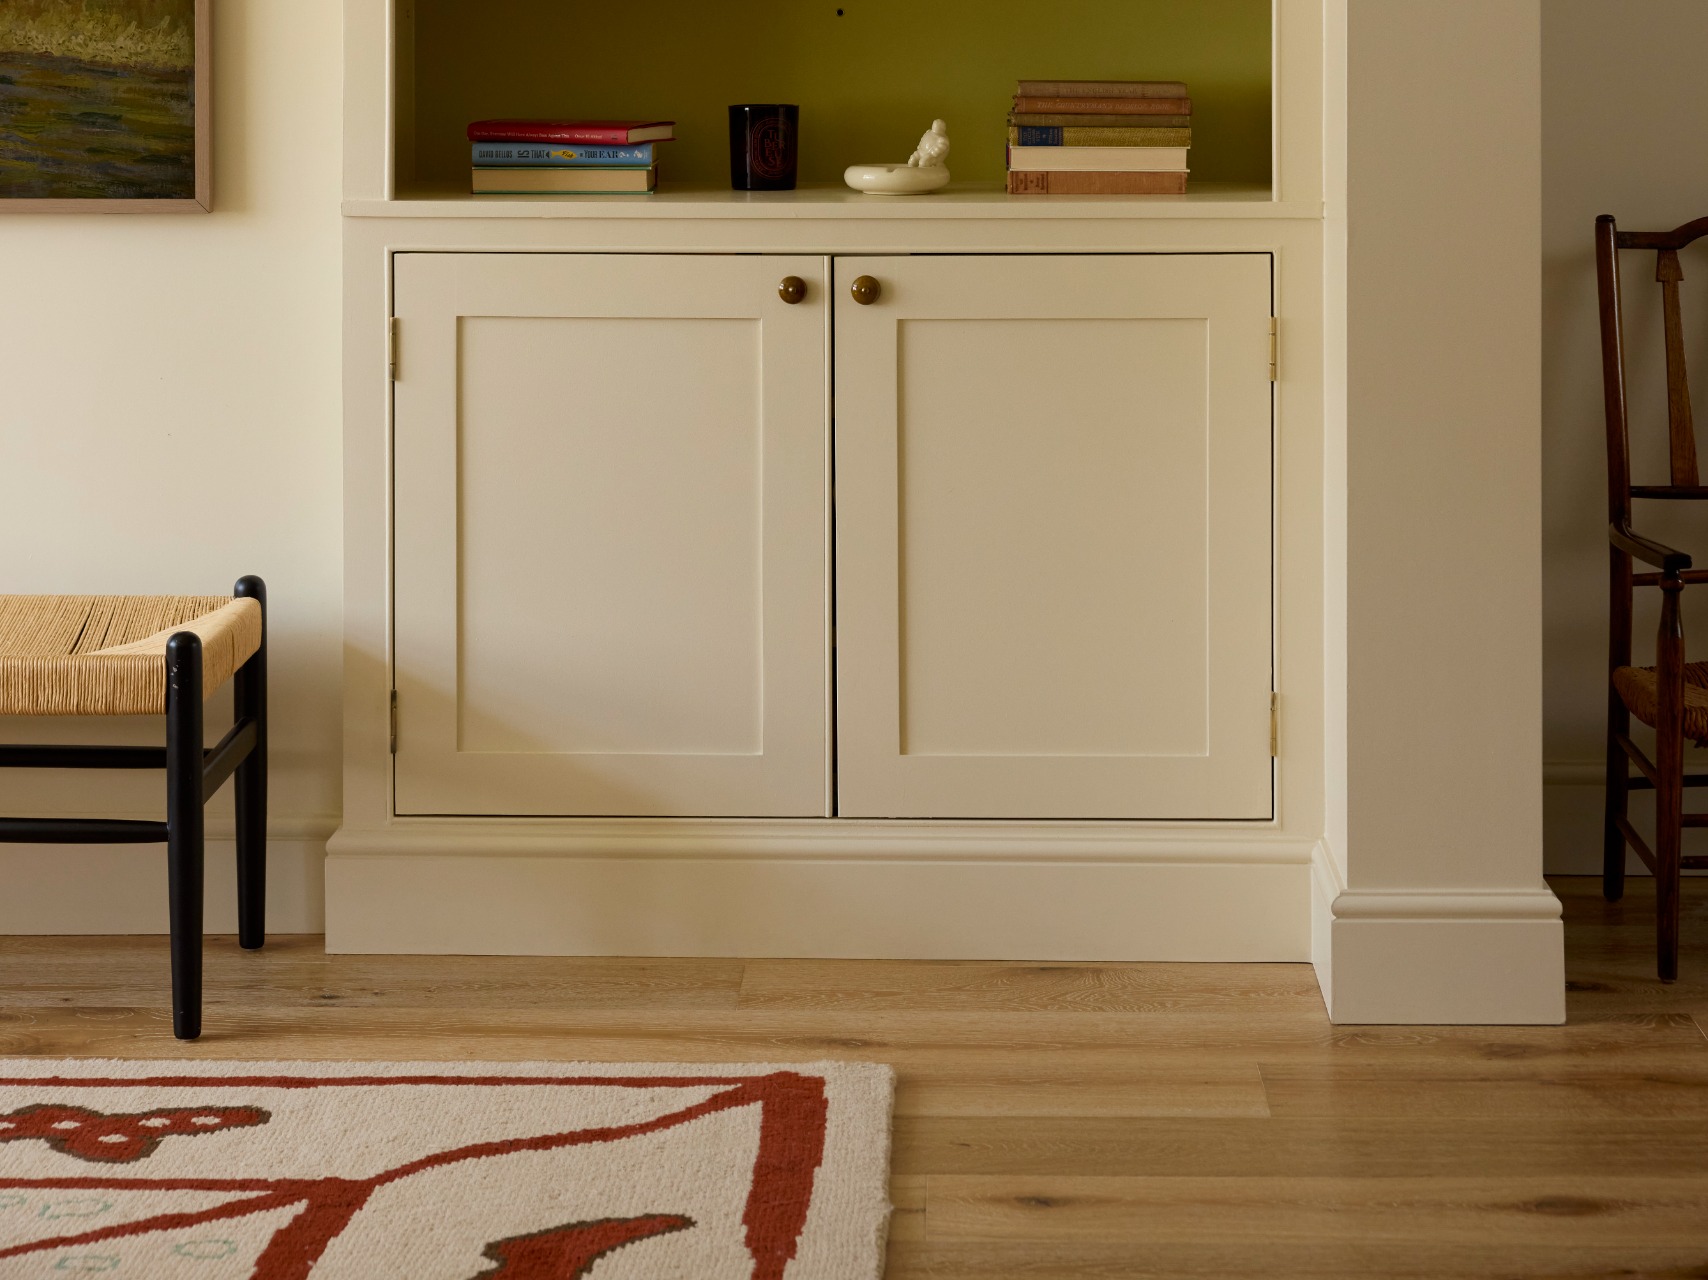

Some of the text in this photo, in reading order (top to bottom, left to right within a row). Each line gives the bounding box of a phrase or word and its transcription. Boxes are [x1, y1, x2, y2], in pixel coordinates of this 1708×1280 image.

[479, 150, 494, 159] DAVID
[495, 150, 513, 159] BELLOS
[531, 150, 545, 159] THAT
